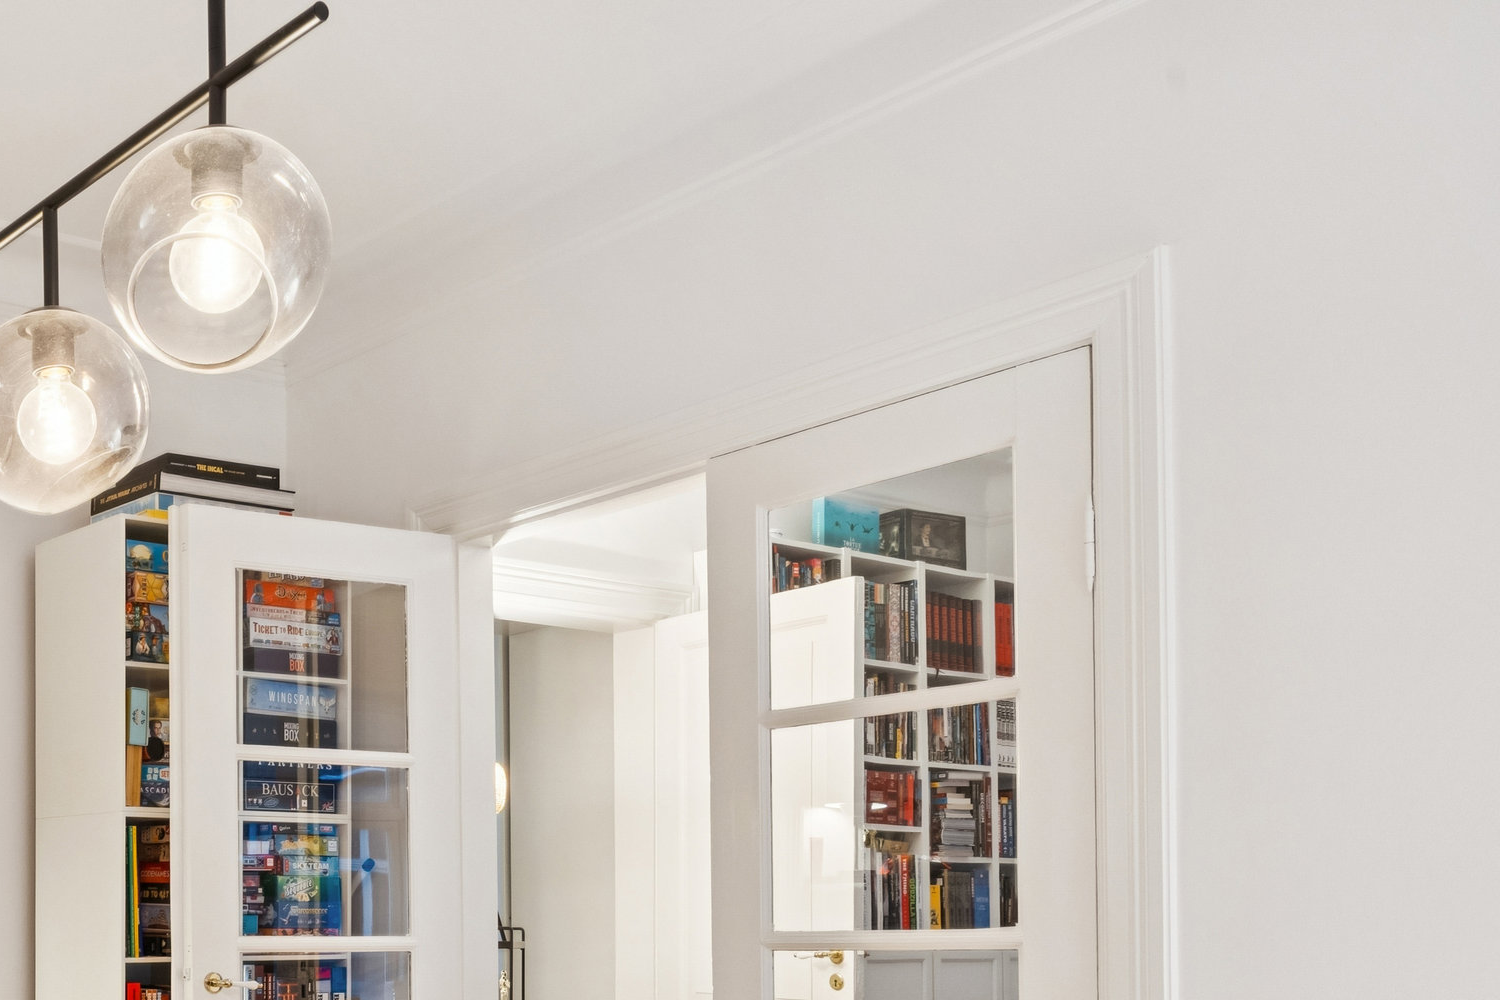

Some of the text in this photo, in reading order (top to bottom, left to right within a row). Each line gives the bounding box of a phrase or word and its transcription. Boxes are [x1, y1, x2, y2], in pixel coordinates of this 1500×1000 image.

[253, 621, 279, 635] TICKET
[287, 625, 304, 637] RIDE
[289, 659, 305, 672] BOX
[268, 690, 317, 707] WINGSPAN
[283, 729, 300, 742] BOX
[140, 785, 170, 794] ASCADI
